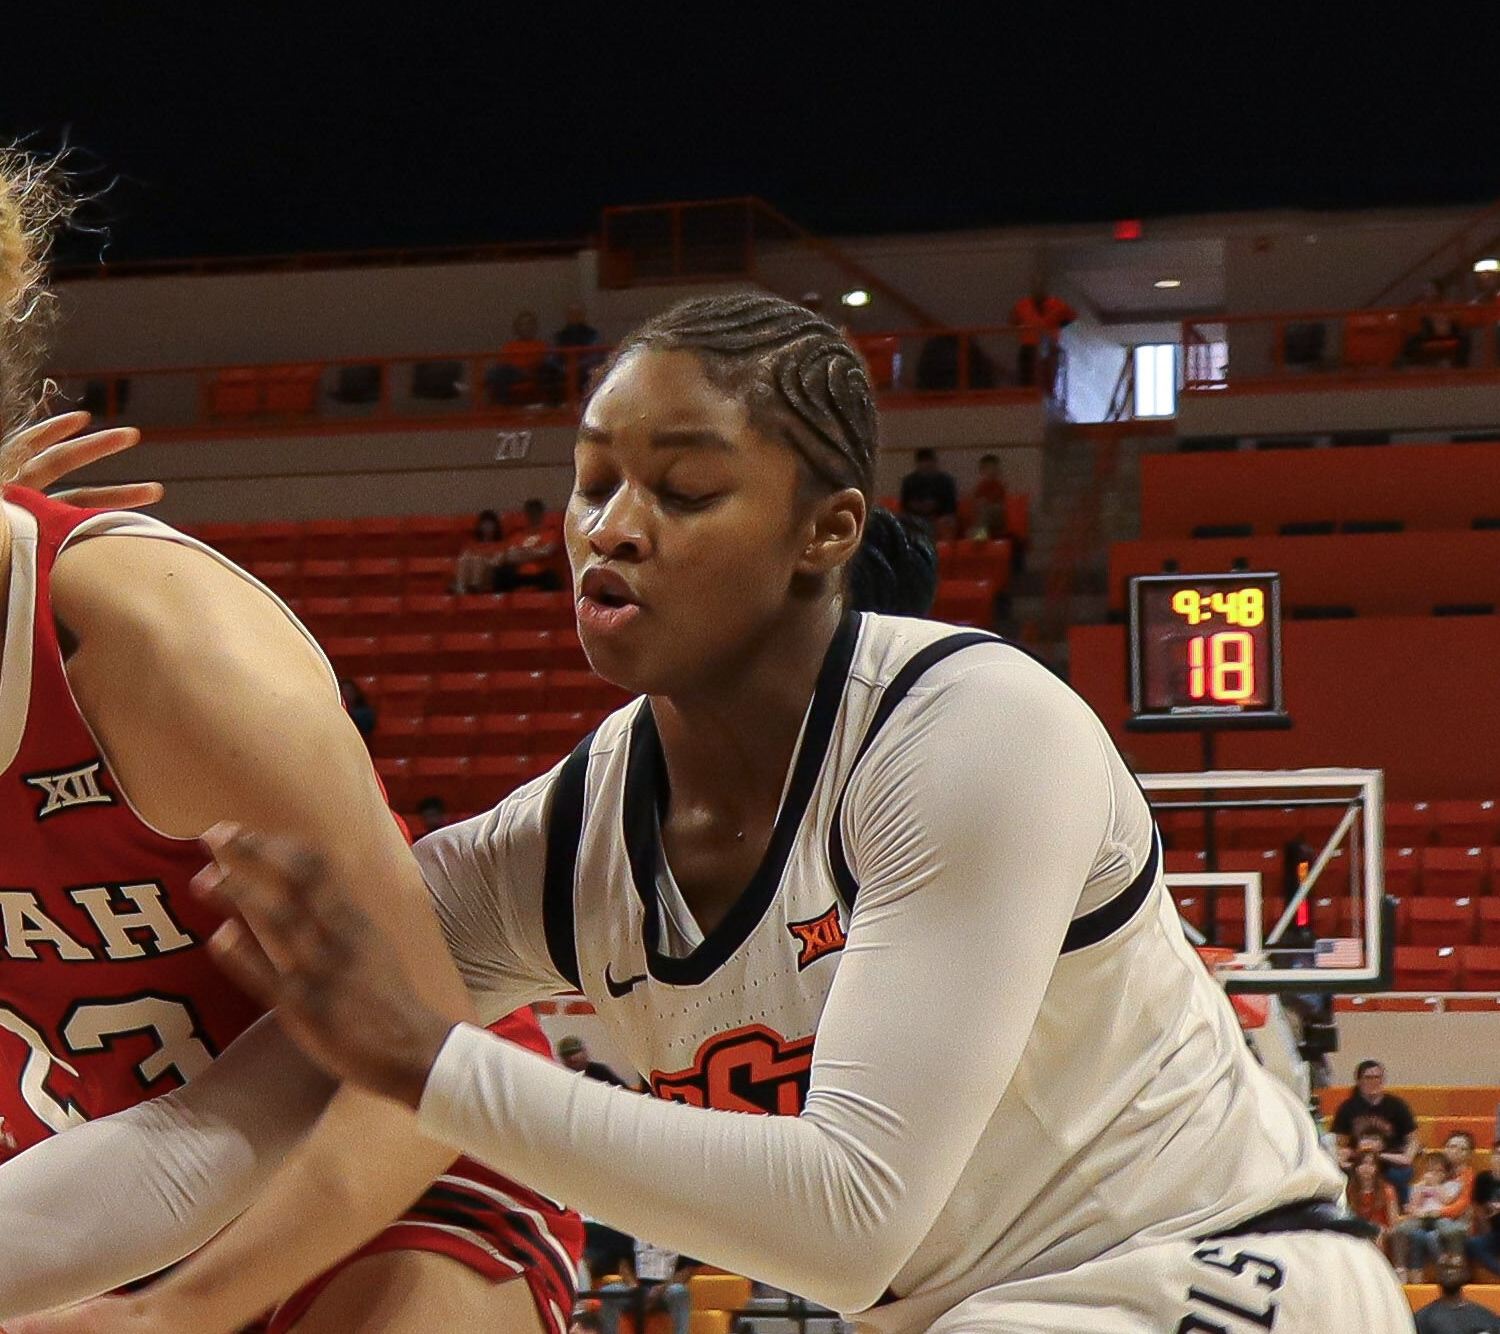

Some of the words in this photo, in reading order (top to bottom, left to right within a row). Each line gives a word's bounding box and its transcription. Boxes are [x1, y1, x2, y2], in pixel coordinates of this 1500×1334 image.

[1172, 588, 1264, 627] 9:48
[1188, 631, 1254, 701] 18
[23, 760, 113, 818] XII
[787, 900, 848, 972] XII
